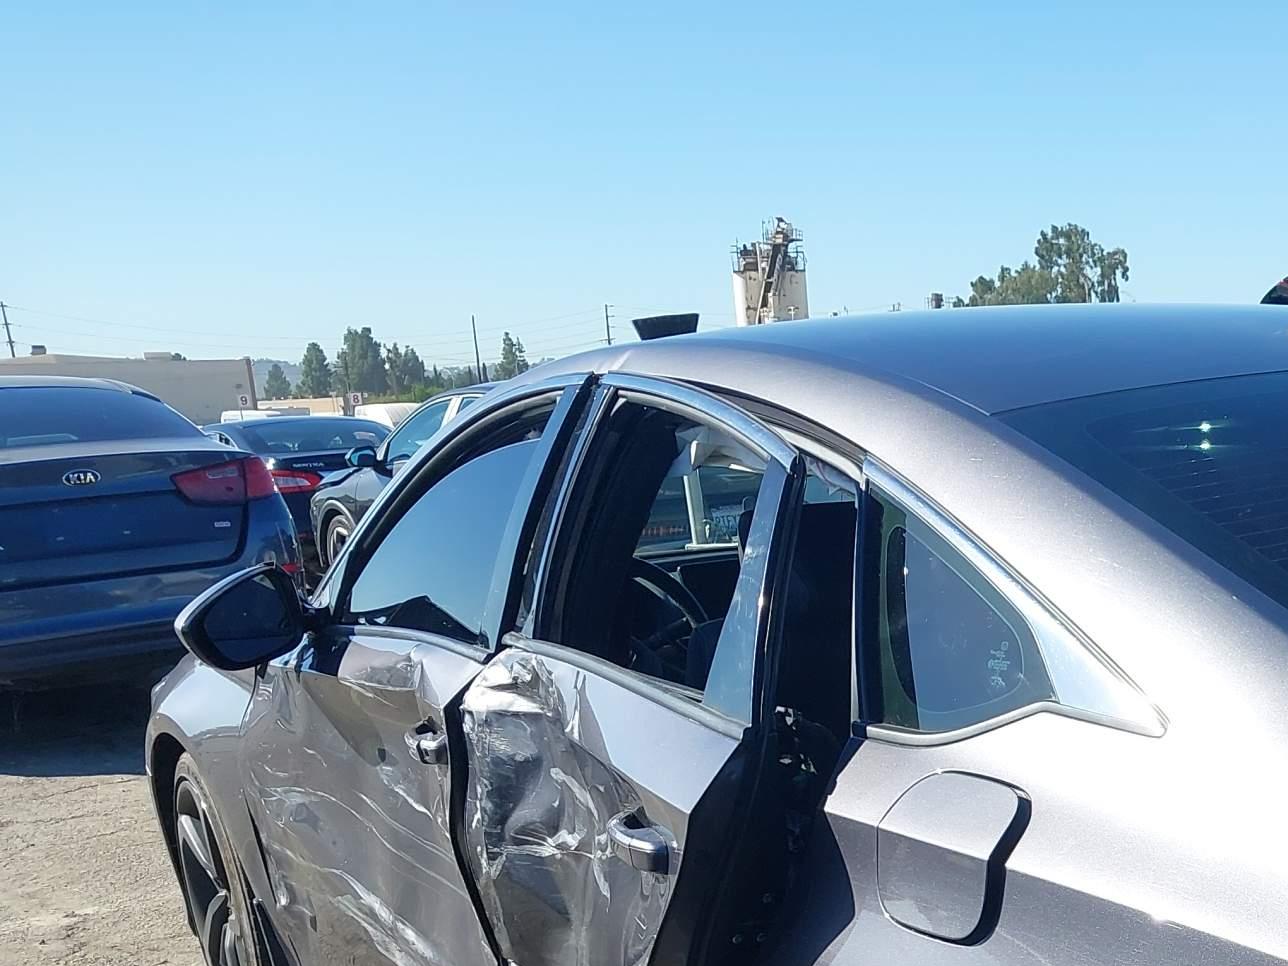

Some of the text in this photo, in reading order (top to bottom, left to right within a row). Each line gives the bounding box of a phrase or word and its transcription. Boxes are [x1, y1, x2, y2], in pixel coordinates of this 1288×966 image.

[240, 395, 248, 406] 9
[352, 394, 360, 404] 8
[69, 472, 96, 484] KIA
